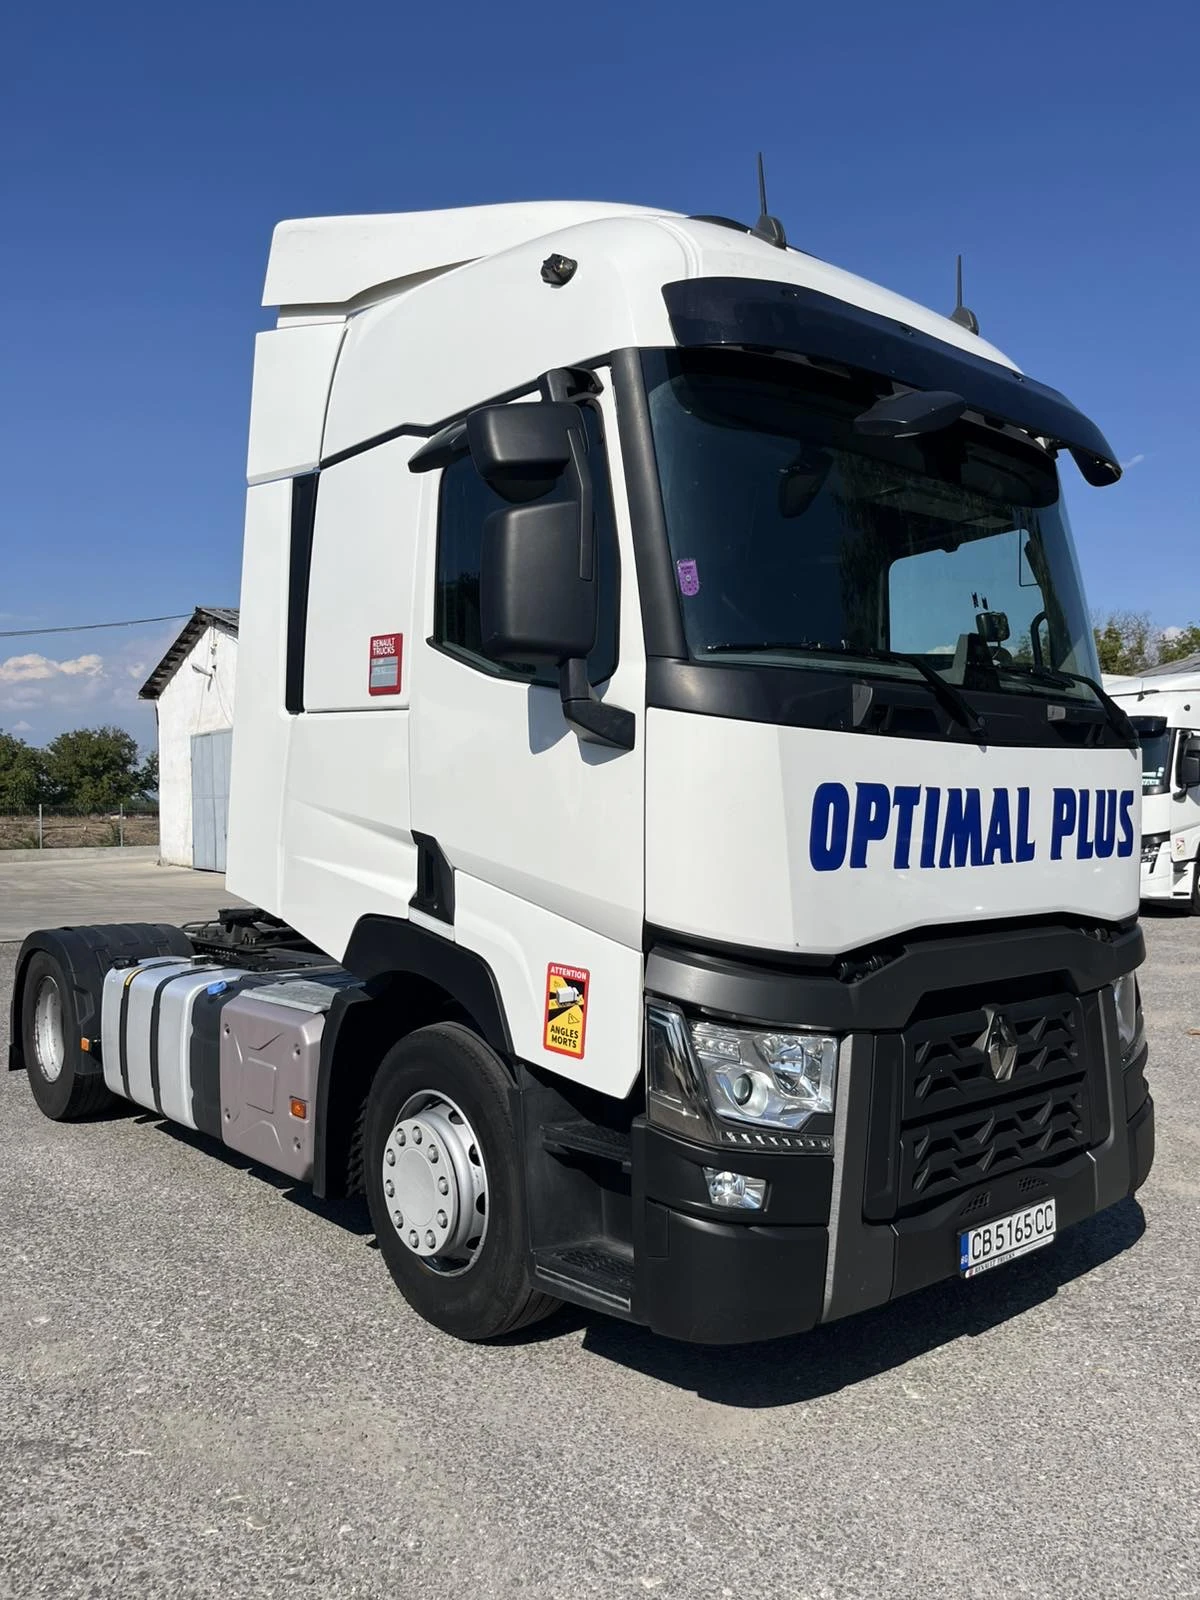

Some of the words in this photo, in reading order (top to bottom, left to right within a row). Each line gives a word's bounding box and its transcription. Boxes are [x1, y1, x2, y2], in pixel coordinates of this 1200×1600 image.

[373, 638, 396, 648] RENAULT
[373, 646, 396, 656] TRUCKS
[809, 781, 1036, 871] OPTIMAL
[1050, 787, 1135, 860] PLUS
[550, 966, 587, 980] ATTENTION
[550, 1025, 579, 1039] ANGLES
[551, 1034, 577, 1049] MORTS
